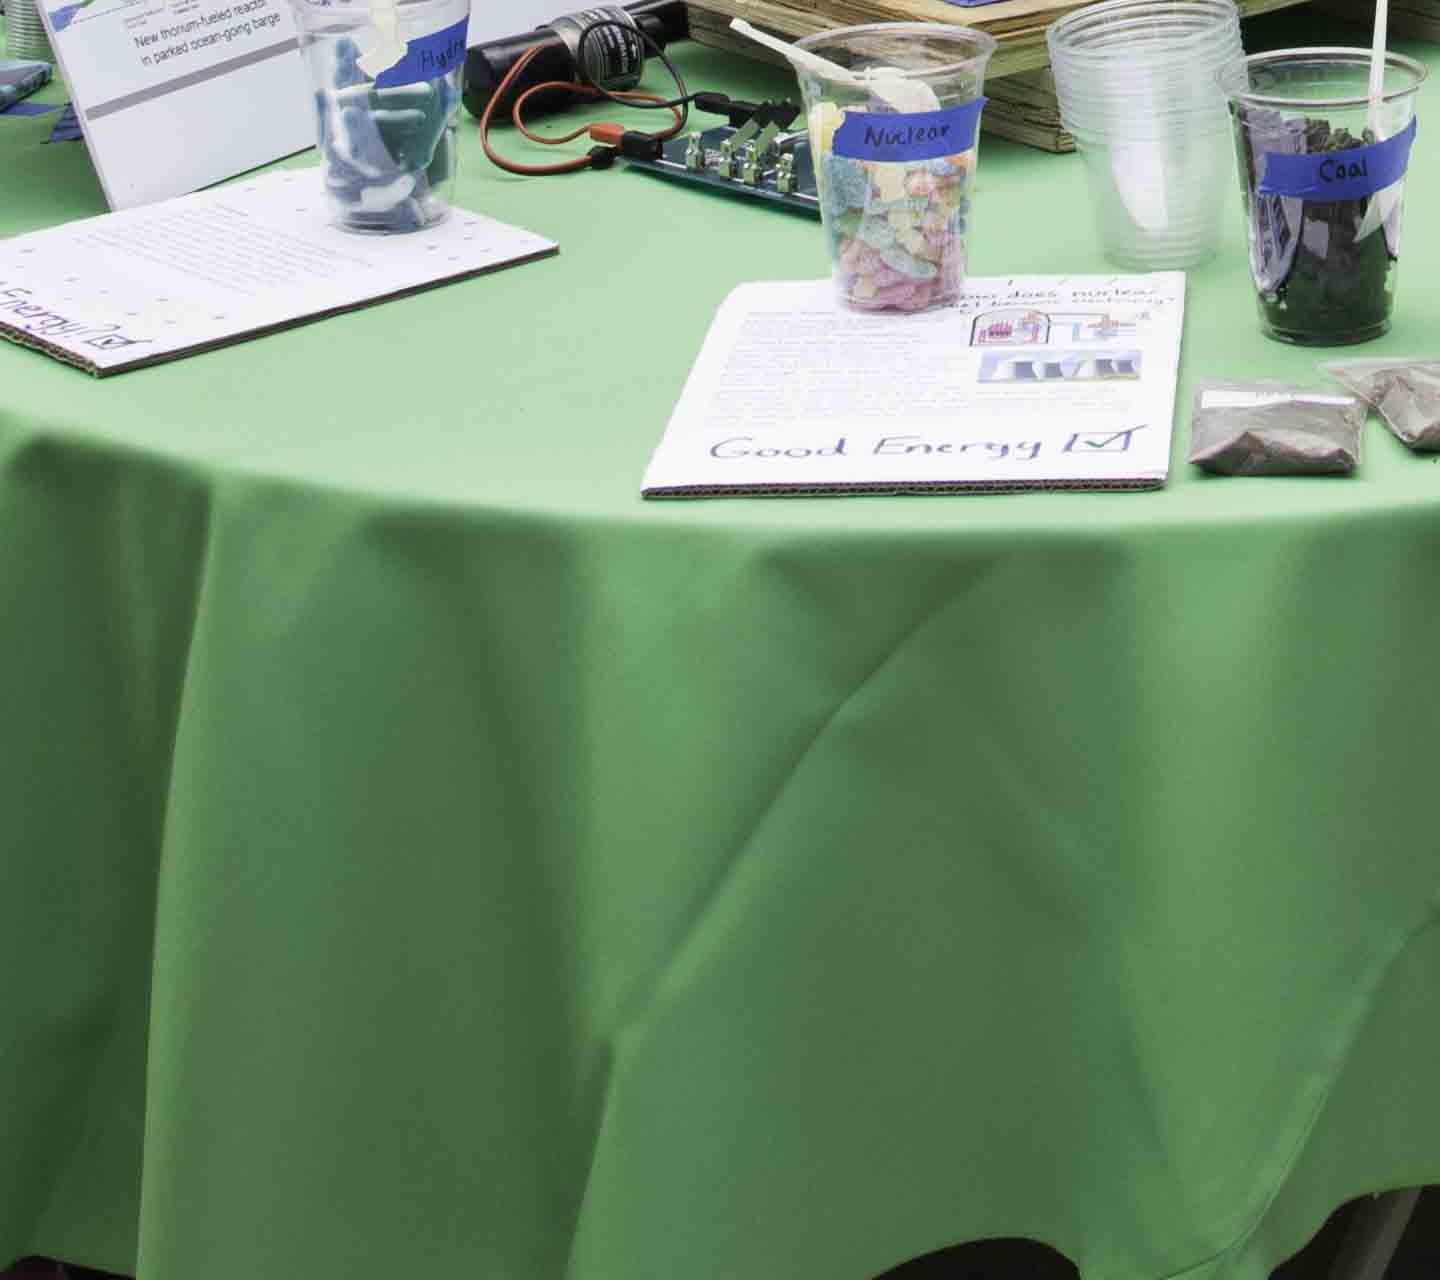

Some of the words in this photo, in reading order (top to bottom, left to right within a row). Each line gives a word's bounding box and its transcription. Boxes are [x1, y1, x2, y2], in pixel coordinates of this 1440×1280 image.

[134, 33, 158, 50] New
[160, 8, 232, 40] thorium-fueled
[142, 54, 152, 67] in
[154, 40, 189, 65] parked
[191, 24, 252, 53] ocean-going
[251, 12, 282, 36] barge
[864, 124, 950, 147] Nuclear
[1320, 156, 1368, 183] Coal
[710, 435, 847, 459] Good
